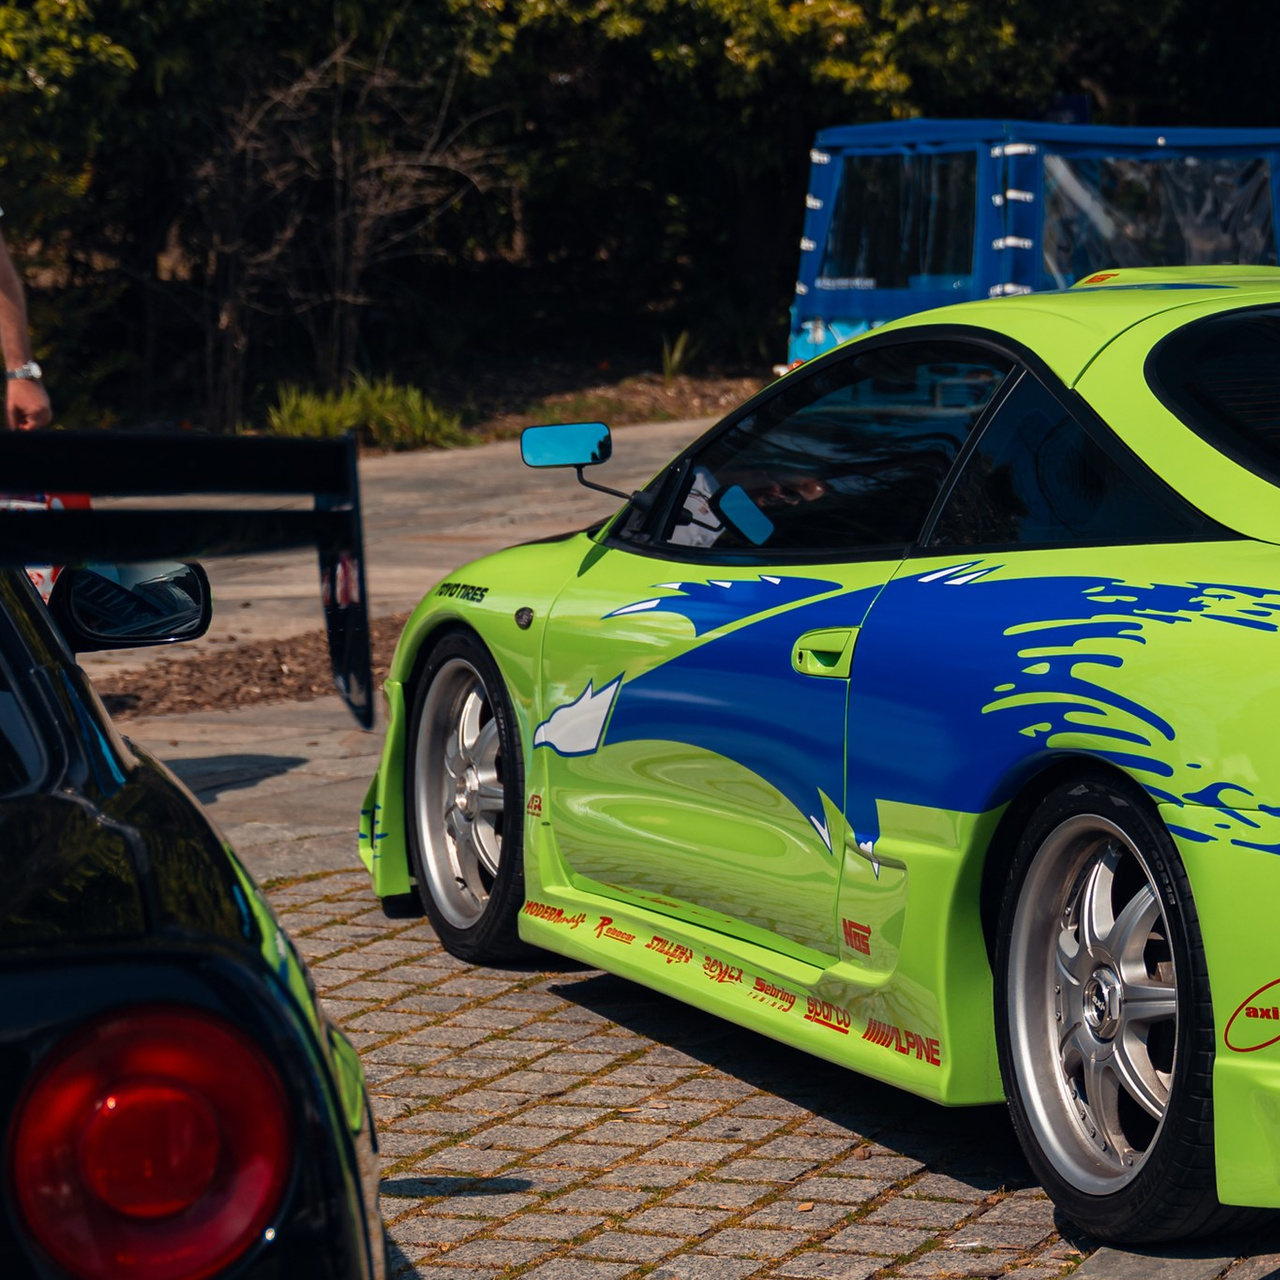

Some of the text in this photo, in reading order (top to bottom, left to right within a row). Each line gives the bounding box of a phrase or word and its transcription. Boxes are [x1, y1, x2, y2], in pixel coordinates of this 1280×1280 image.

[456, 584, 490, 604] TIRES
[753, 977, 796, 1012] Sebring
[806, 996, 851, 1028] sparco
